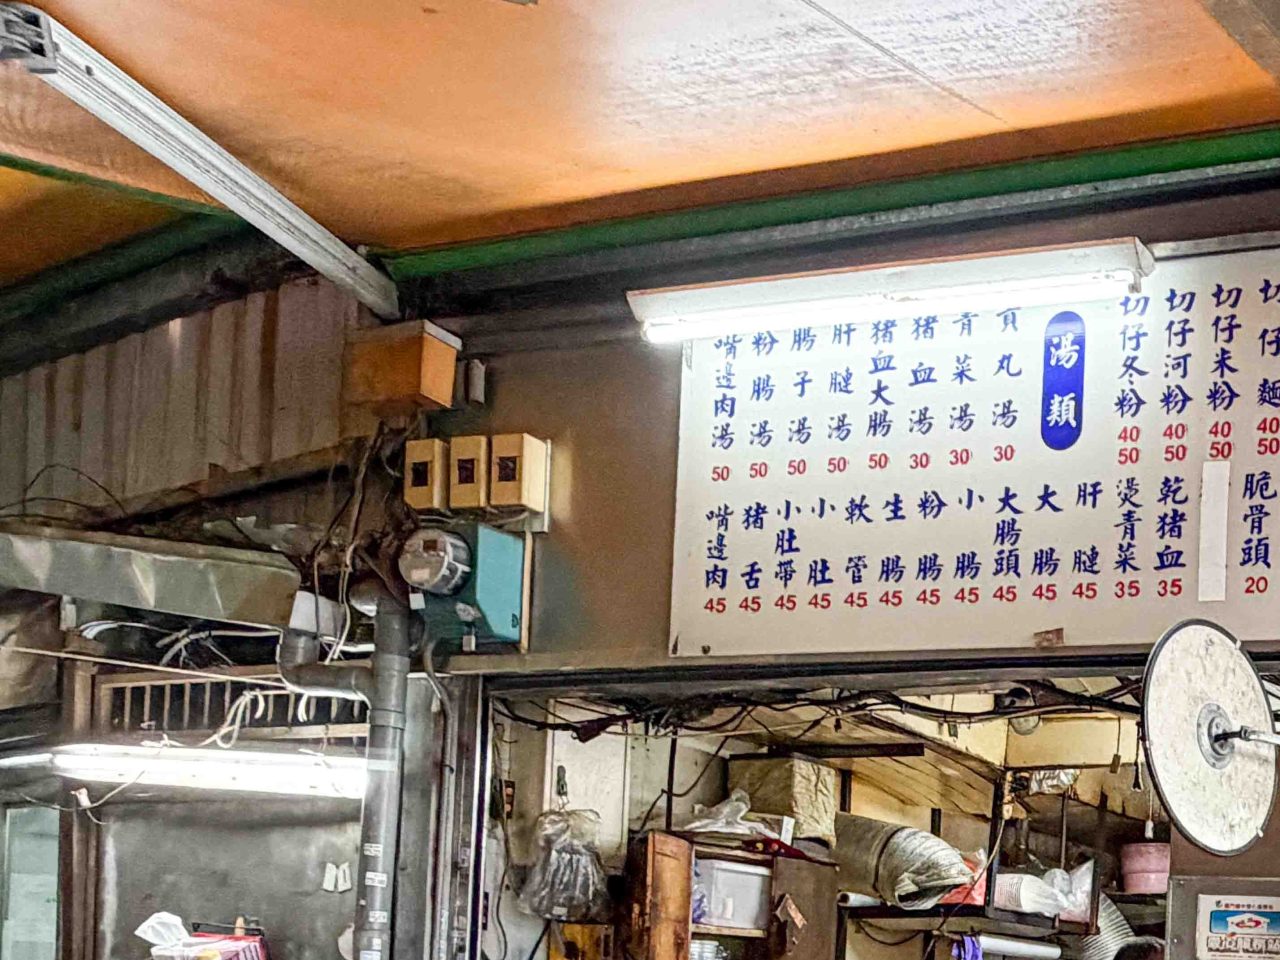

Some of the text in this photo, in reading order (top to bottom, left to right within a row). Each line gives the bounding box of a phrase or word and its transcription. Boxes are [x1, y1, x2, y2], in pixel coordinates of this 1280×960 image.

[711, 334, 742, 481] 嘴邊肉湯 50
[750, 331, 779, 480] 粉腸湯 50
[788, 327, 816, 476] 腸子湯 50
[949, 312, 979, 466] 青菜湯 30
[1045, 335, 1080, 429] 湯類
[1114, 291, 1150, 465] 切仔冬粉 40 50
[1160, 288, 1196, 464] 切仔河粉 40 50
[1206, 284, 1242, 460] 切仔米粉 40 50
[1256, 415, 1280, 436] 40
[827, 457, 848, 472] 50
[867, 453, 888, 470] 50
[909, 452, 930, 470] 30
[993, 444, 1016, 463] 30
[1255, 437, 1280, 458] 50
[705, 504, 734, 615] 嘴邊肉 45
[807, 497, 836, 609] 小肚 45
[844, 494, 873, 609] 軟管 45
[878, 493, 906, 608] 生腸 45
[916, 490, 948, 606] 粉腸 45
[953, 488, 984, 605] 小腸 45
[991, 486, 1024, 604] 大腸頭 45
[1031, 484, 1063, 603] 大腸 45
[1071, 581, 1098, 601] 45
[1113, 477, 1143, 600] 燙青菜 35
[1157, 577, 1183, 599] 35
[1239, 471, 1277, 596] 脆骨頭 20
[739, 596, 761, 614] 45
[774, 594, 798, 612] 45
